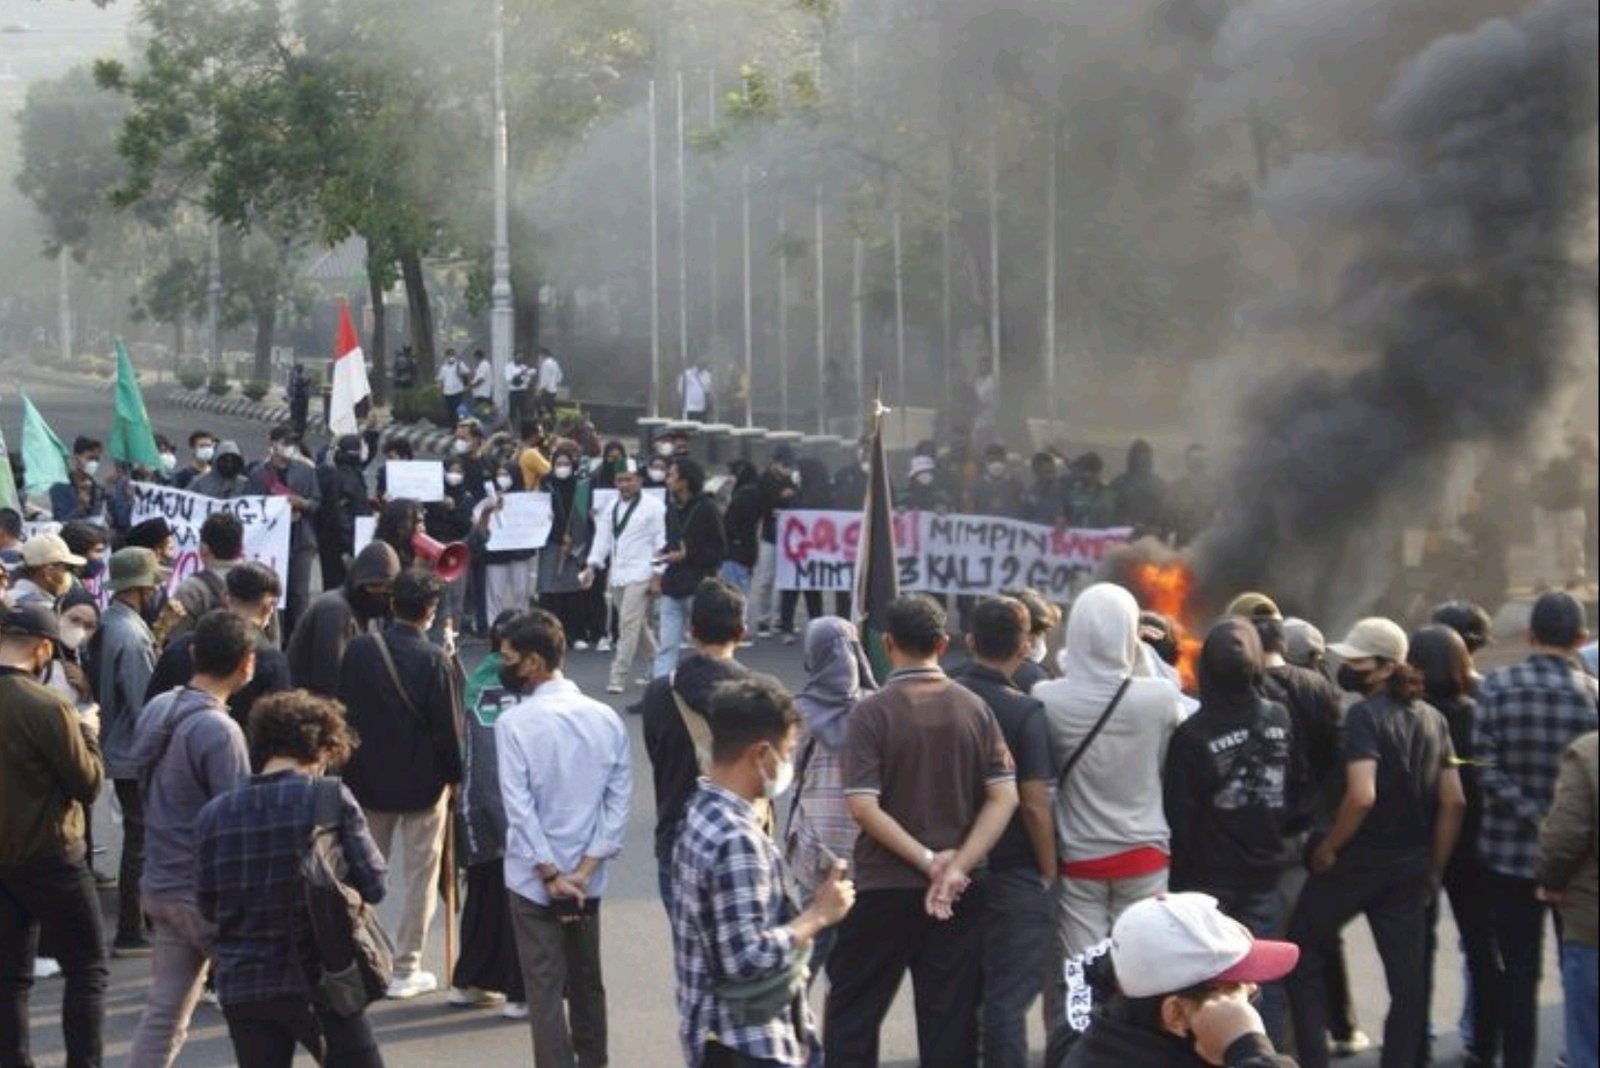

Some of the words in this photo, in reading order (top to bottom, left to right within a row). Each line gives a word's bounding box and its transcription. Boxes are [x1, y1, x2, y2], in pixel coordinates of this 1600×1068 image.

[134, 485, 194, 521] MAJU
[929, 517, 1048, 555] MIMPIN
[898, 556, 920, 585] 3
